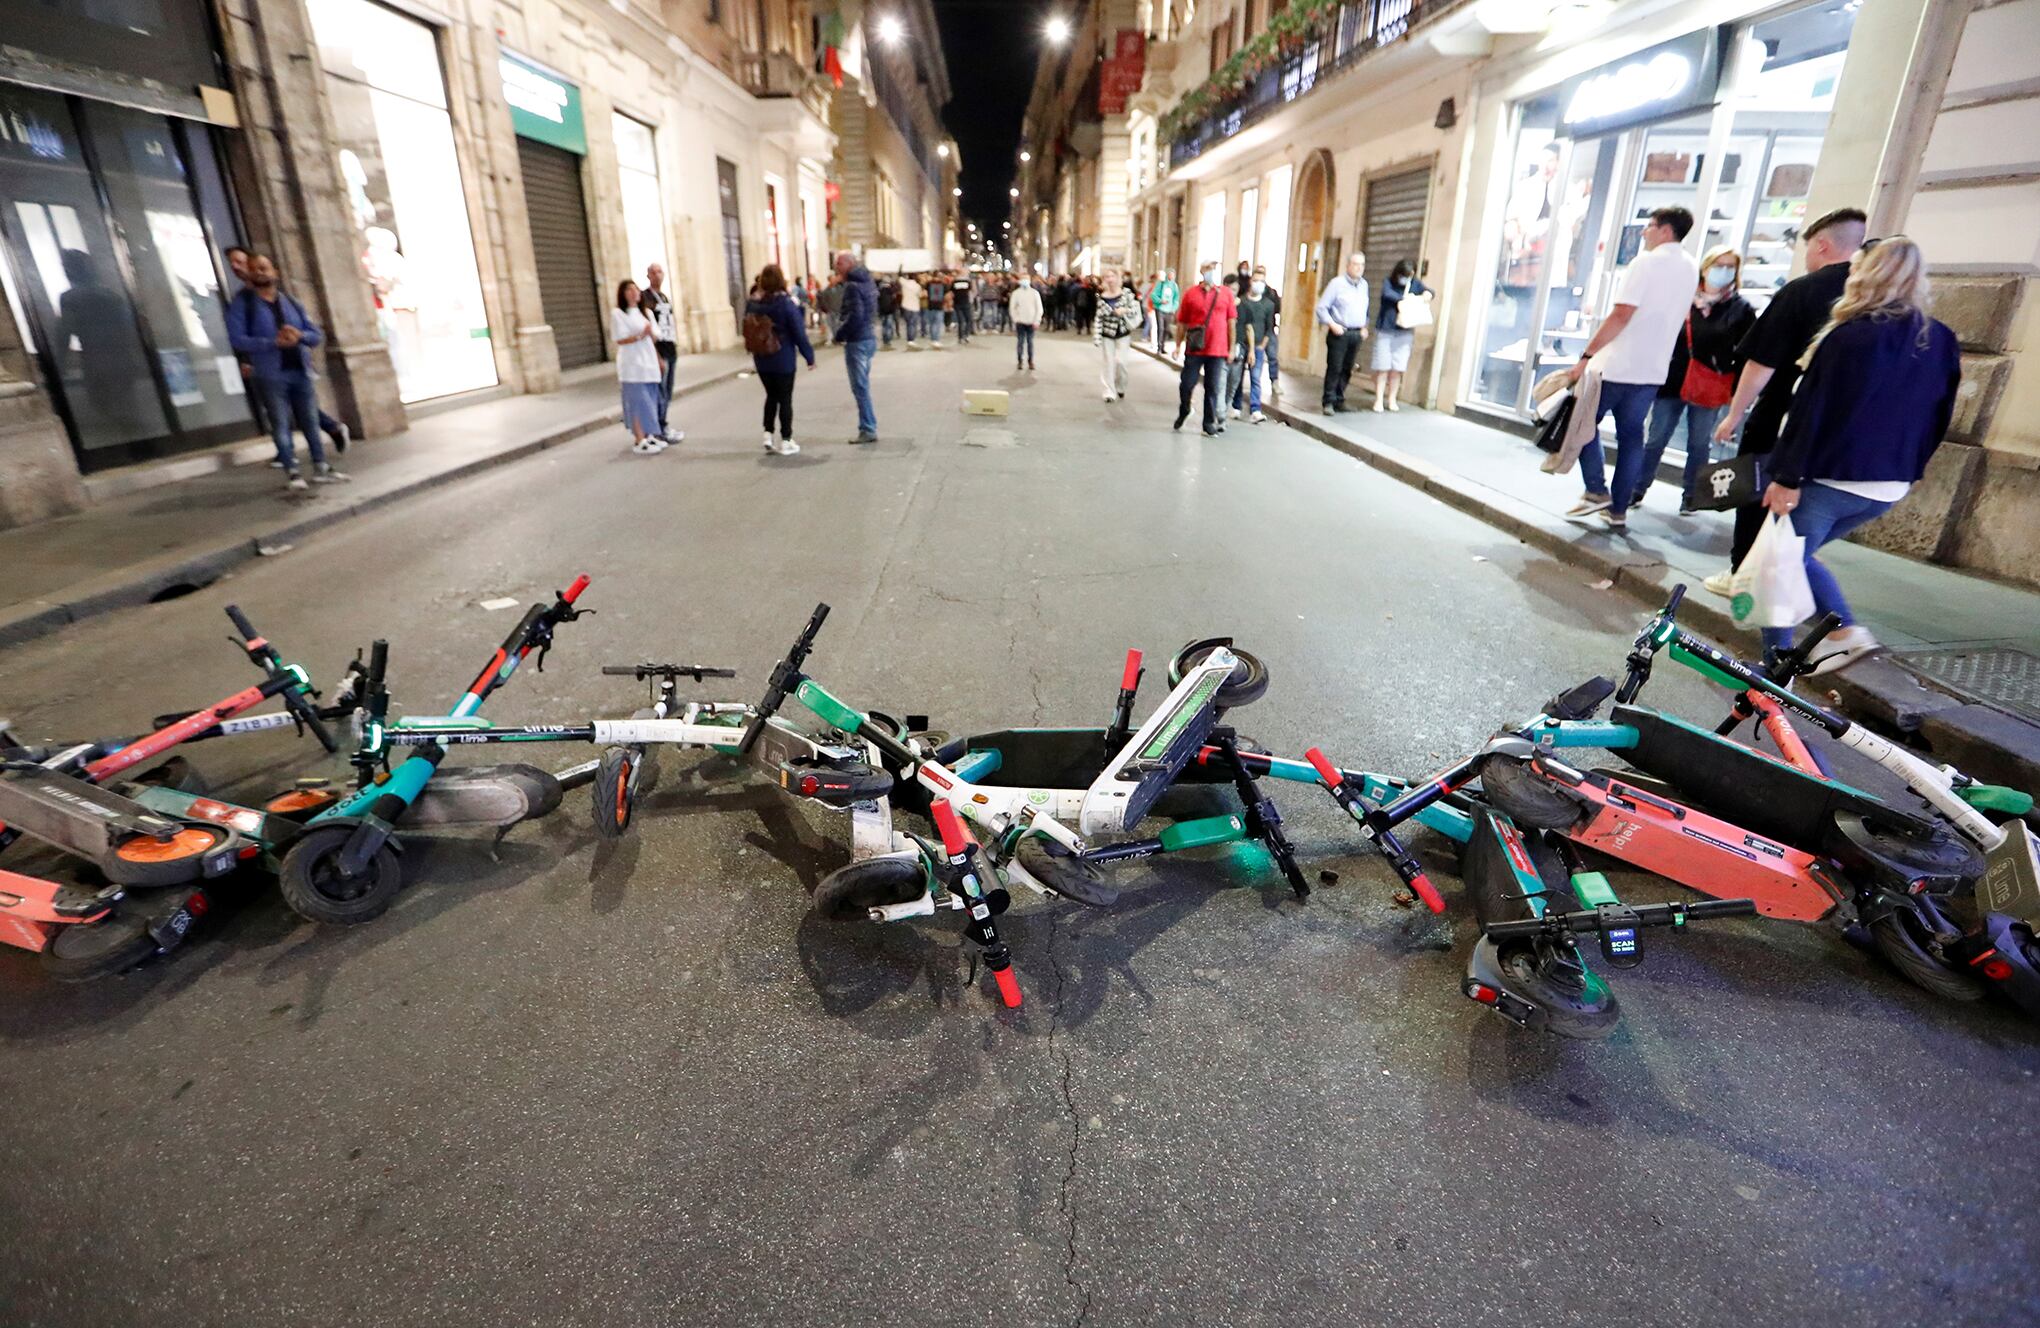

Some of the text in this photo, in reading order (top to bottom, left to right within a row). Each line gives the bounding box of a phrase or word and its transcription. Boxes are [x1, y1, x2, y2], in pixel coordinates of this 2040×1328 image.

[1729, 659, 1752, 677] Lime
[230, 713, 296, 733] HELBIZ
[459, 734, 488, 743] Lime
[1155, 725, 1179, 746] Lime
[327, 788, 370, 817] dott
[1612, 822, 1643, 851] help!
[1993, 875, 2011, 904] Lime
[1611, 940, 1635, 948] SCAN
